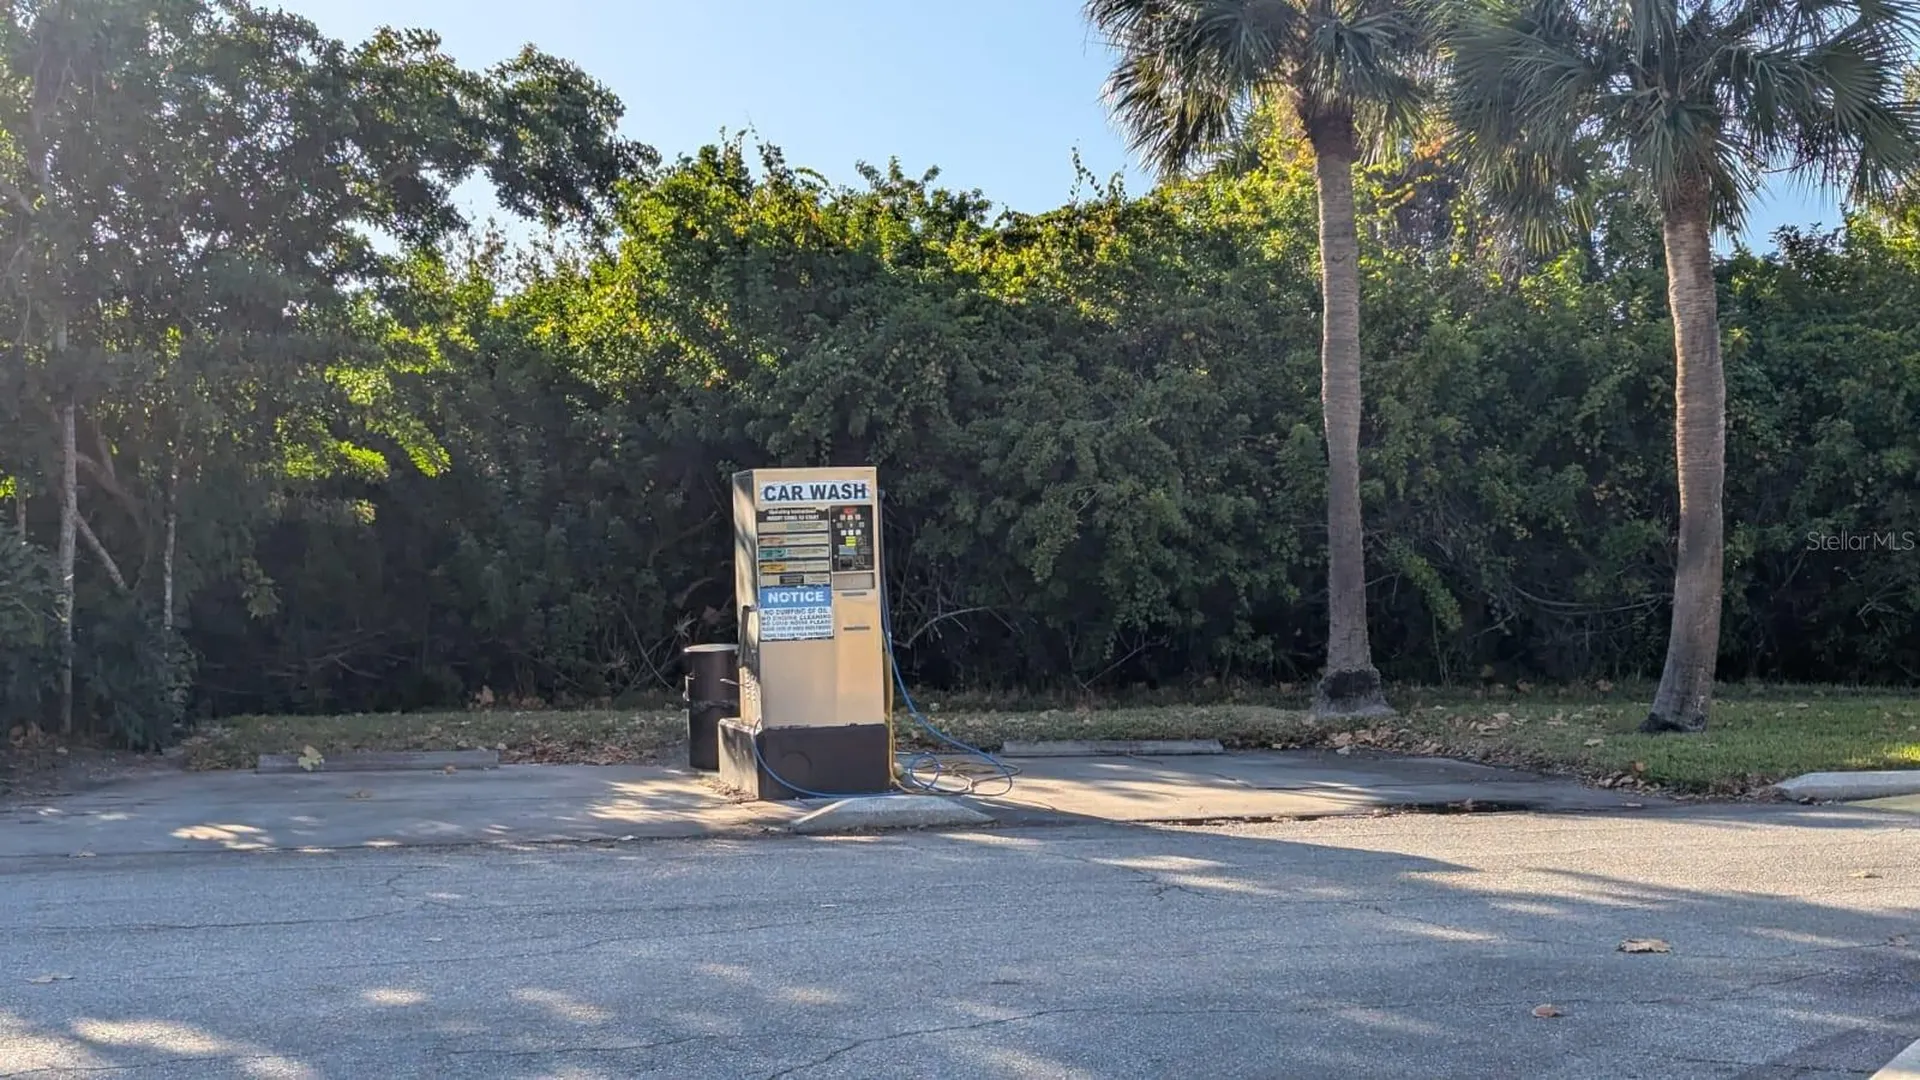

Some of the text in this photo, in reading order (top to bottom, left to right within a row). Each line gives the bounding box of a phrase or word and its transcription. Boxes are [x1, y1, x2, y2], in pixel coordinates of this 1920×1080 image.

[764, 483, 866, 501] CAR WASH
[767, 591, 825, 604] NOTICE
